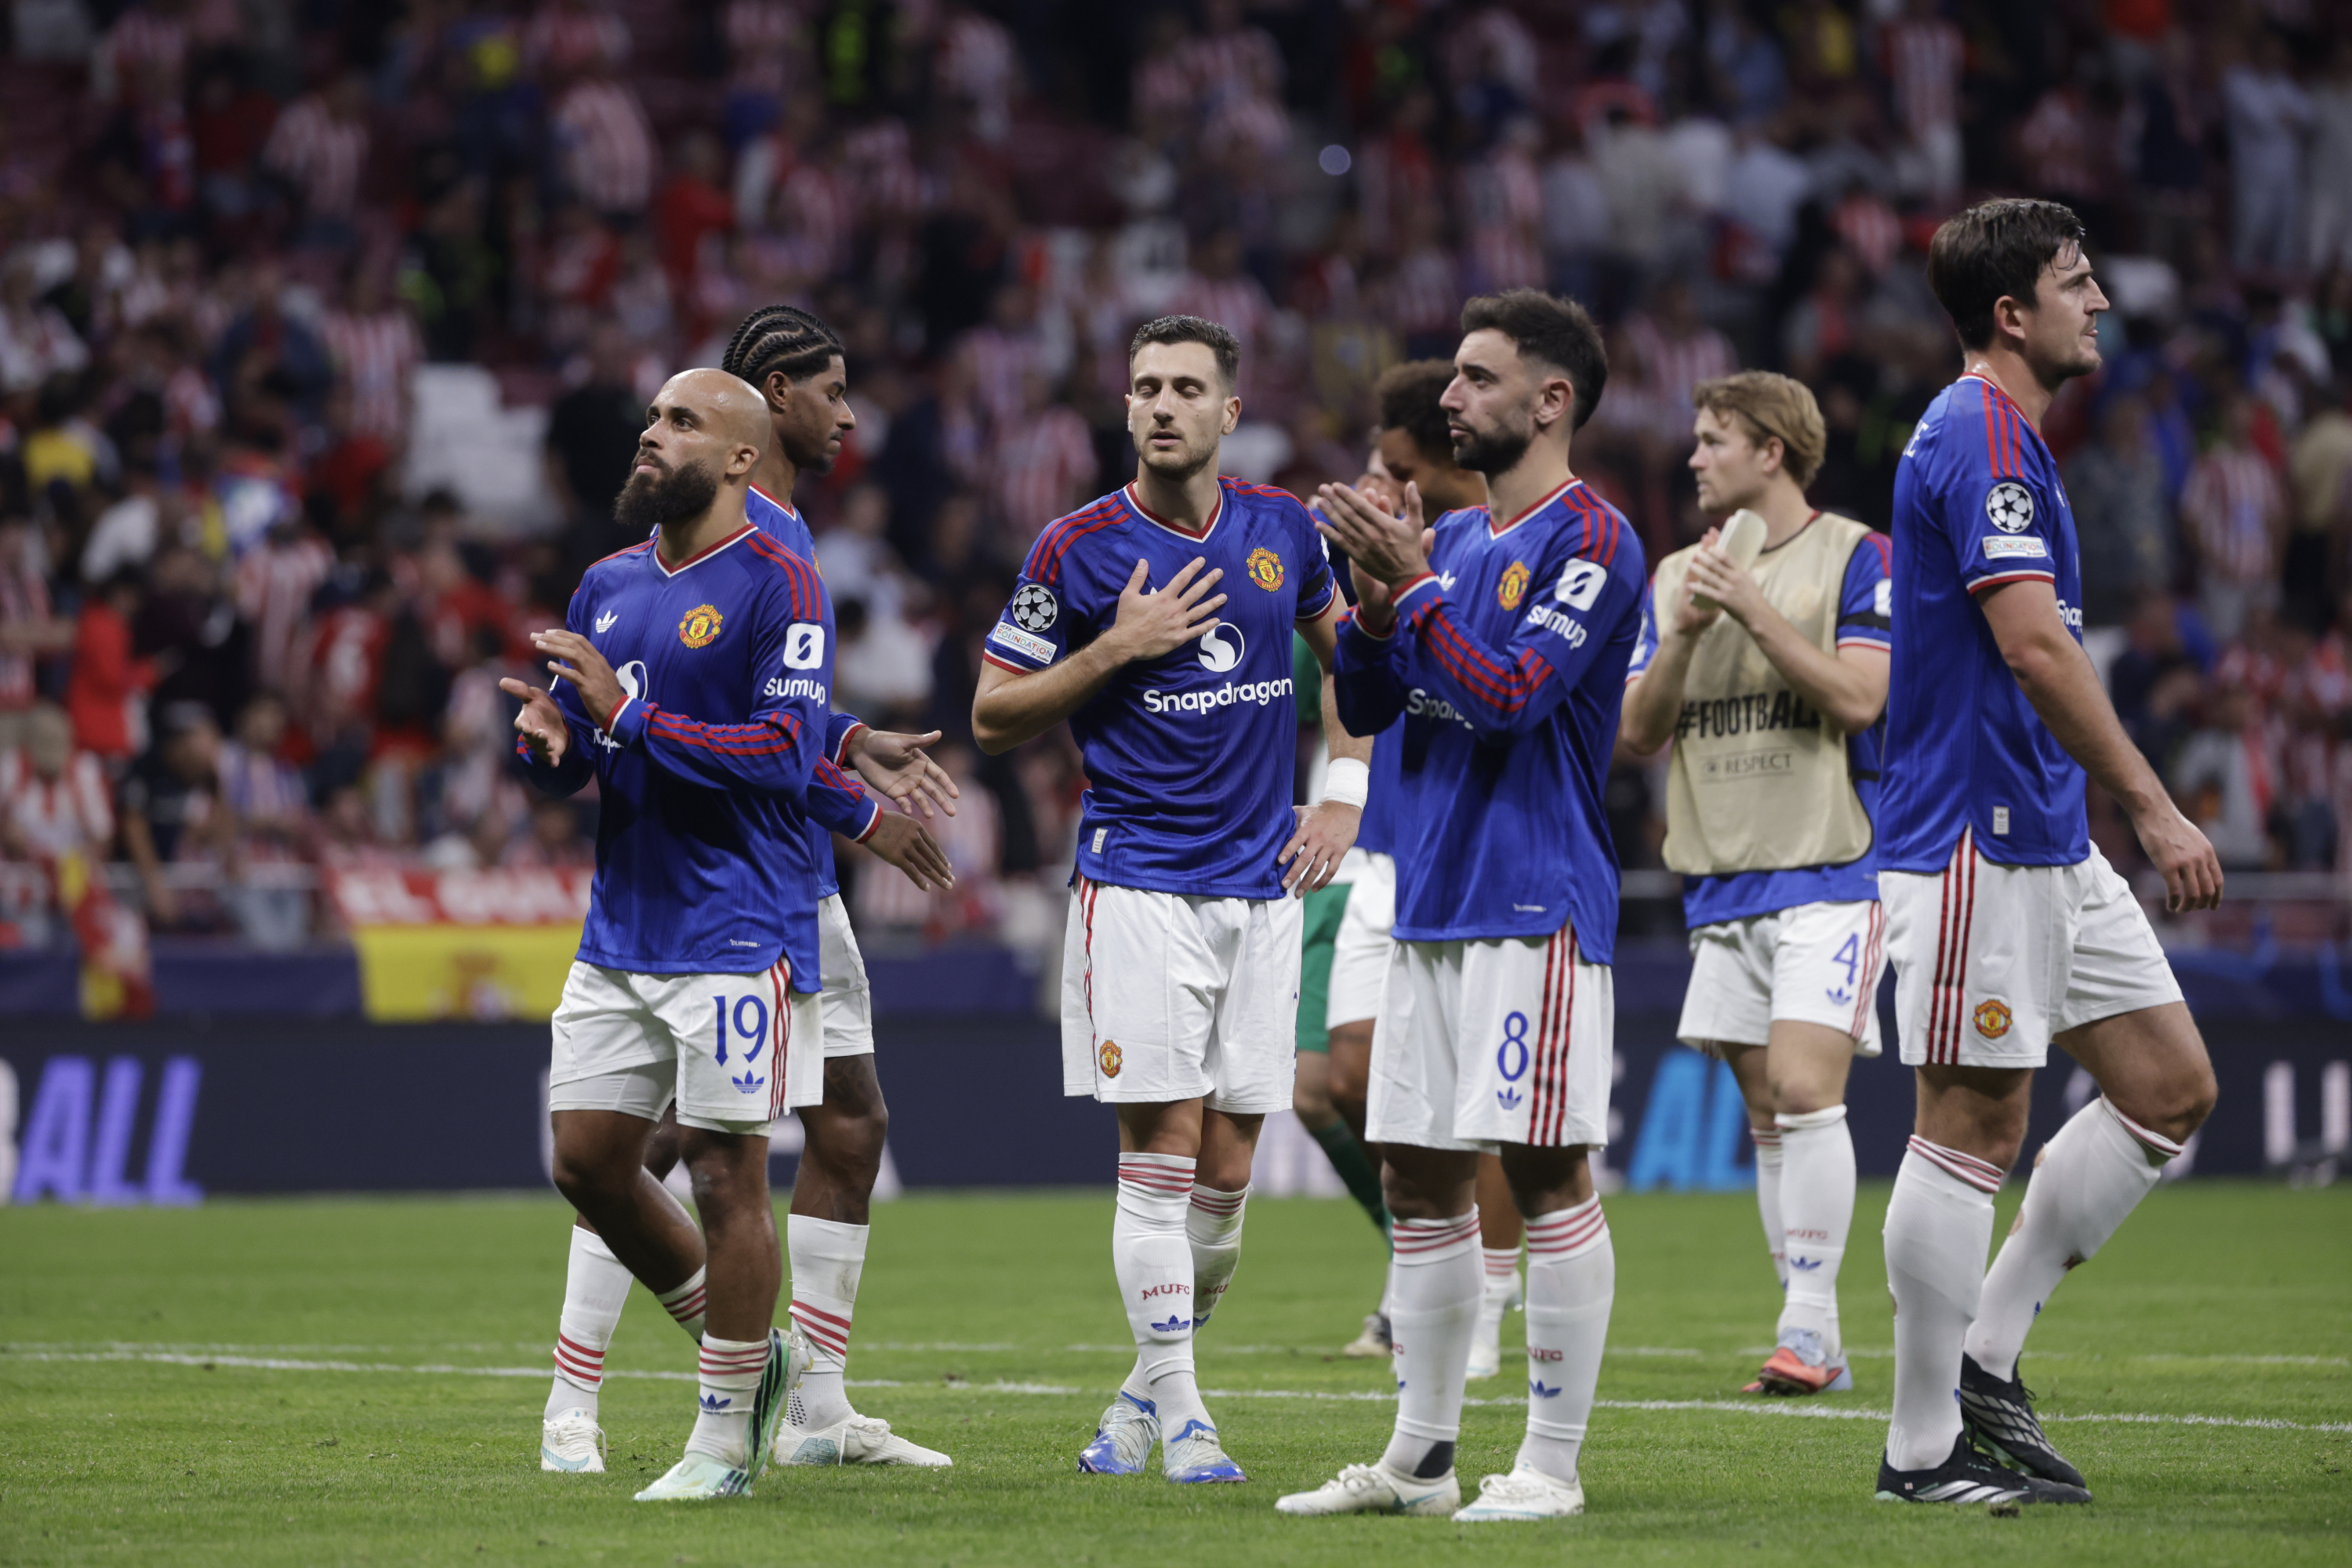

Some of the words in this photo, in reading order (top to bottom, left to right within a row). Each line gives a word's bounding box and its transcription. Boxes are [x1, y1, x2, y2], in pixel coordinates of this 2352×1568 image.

[1261, 579, 1281, 589] UNITED
[686, 608, 720, 624] MANCHESTER
[1526, 604, 1588, 650] sumup
[683, 636, 707, 645] UNITED
[764, 677, 826, 709] sumup
[1143, 678, 1293, 715] Snapdragon
[1726, 752, 1791, 774] RESPECT
[1831, 932, 1859, 986] 4
[712, 994, 768, 1068] 19
[1497, 1011, 1529, 1082] 8
[1142, 1283, 1190, 1301] MUFC
